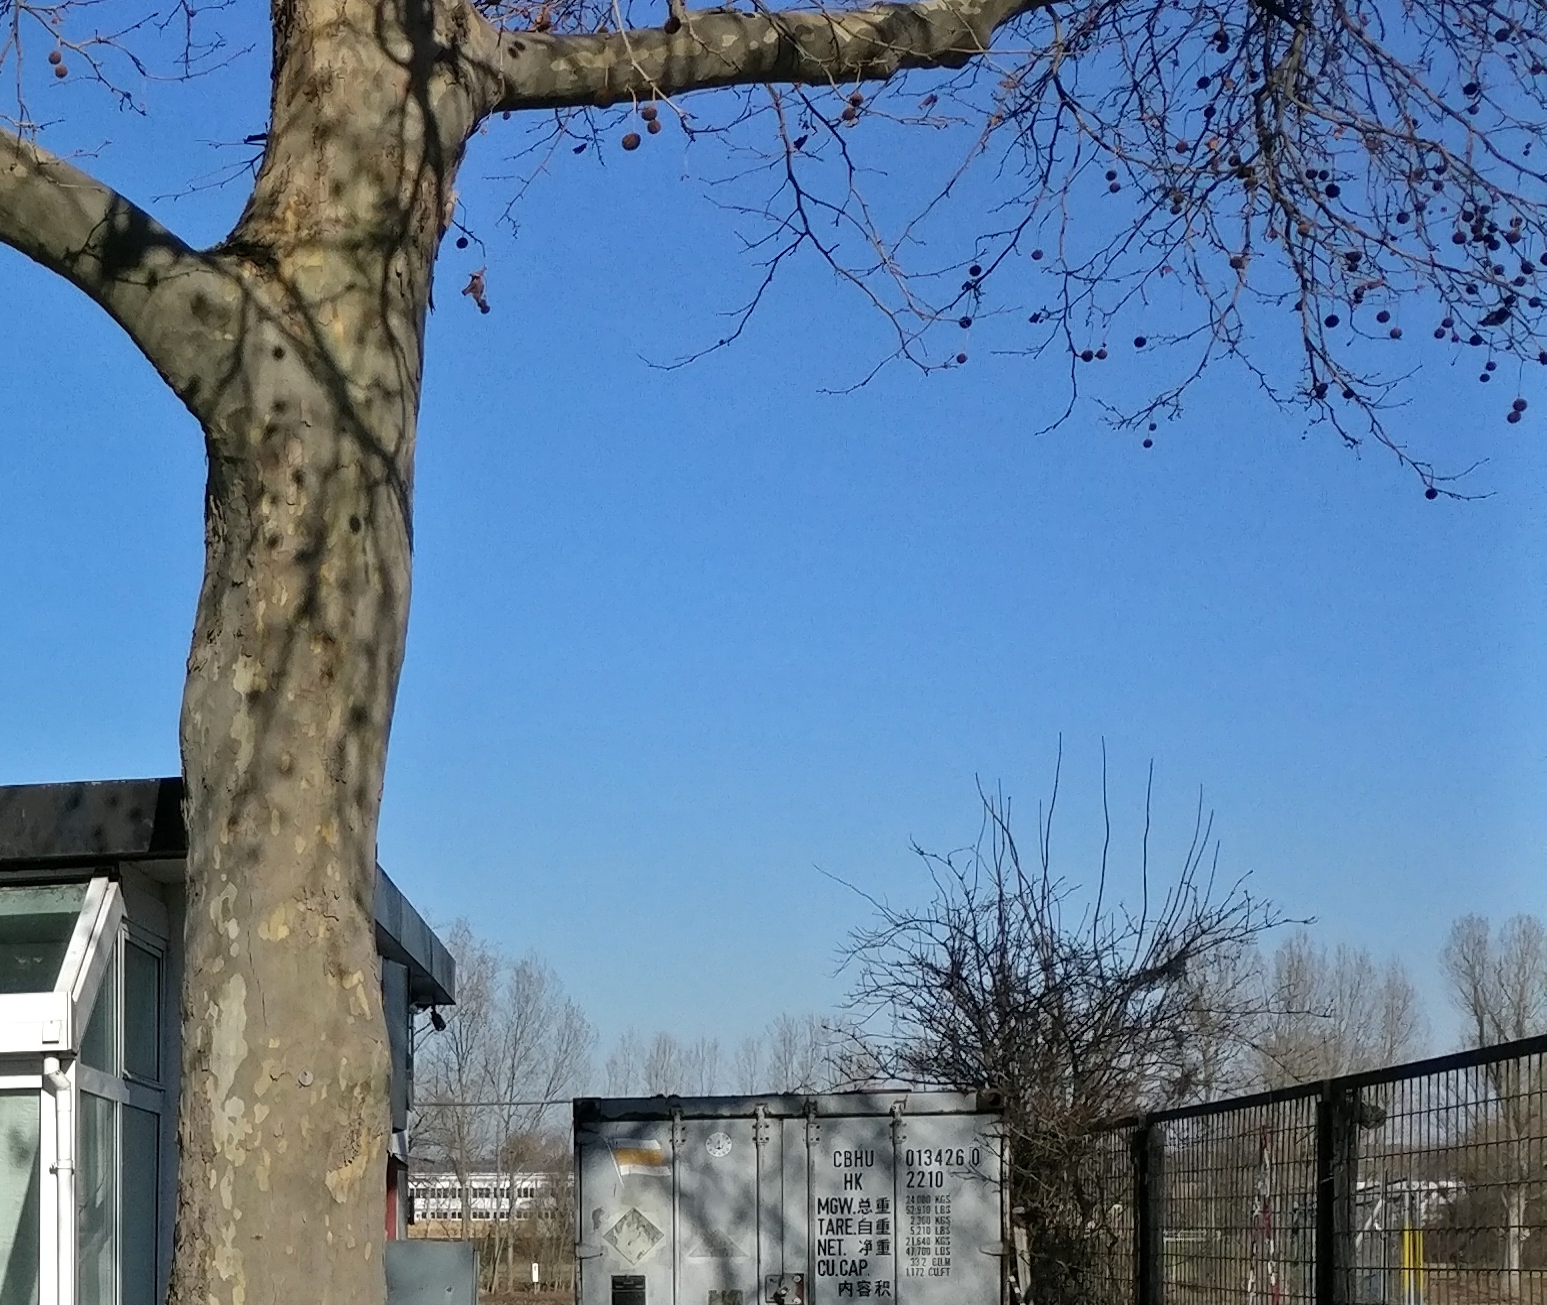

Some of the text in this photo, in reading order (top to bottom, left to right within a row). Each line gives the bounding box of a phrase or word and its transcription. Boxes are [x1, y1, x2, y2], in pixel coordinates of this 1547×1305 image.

[833, 1148, 981, 1168] CBHU 013426 0
[843, 1170, 944, 1191] HK 2210
[817, 1197, 856, 1215] MGW.
[935, 1194, 951, 1204] KGS
[817, 1218, 857, 1236] TARE.
[935, 1216, 951, 1226] KGS
[935, 1226, 951, 1235] LBS
[817, 1239, 847, 1256] NET.
[935, 1236, 951, 1246] KGS
[817, 1259, 870, 1276] CU.CAP.
[838, 1280, 891, 1298] 内容积
